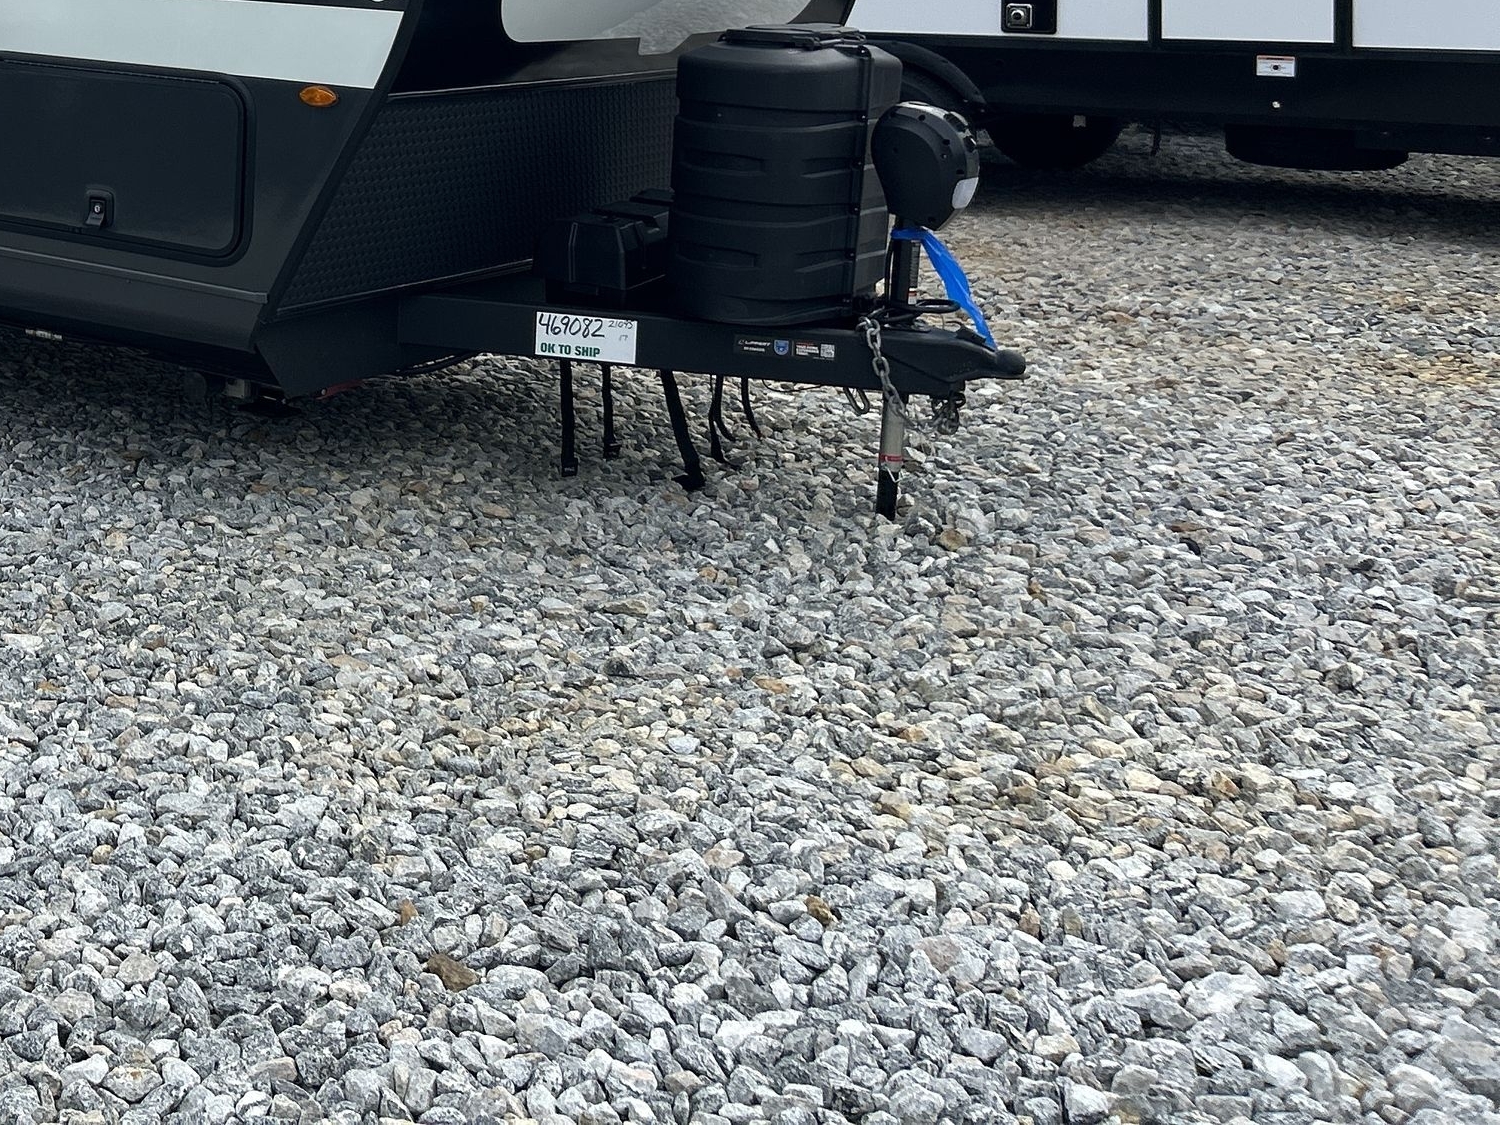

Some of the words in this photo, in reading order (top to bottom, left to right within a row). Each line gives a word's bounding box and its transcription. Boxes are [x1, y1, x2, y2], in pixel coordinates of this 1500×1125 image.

[538, 313, 605, 339] 469082
[540, 342, 556, 354] OK
[558, 344, 572, 356] TO
[574, 345, 601, 358] SHIP
